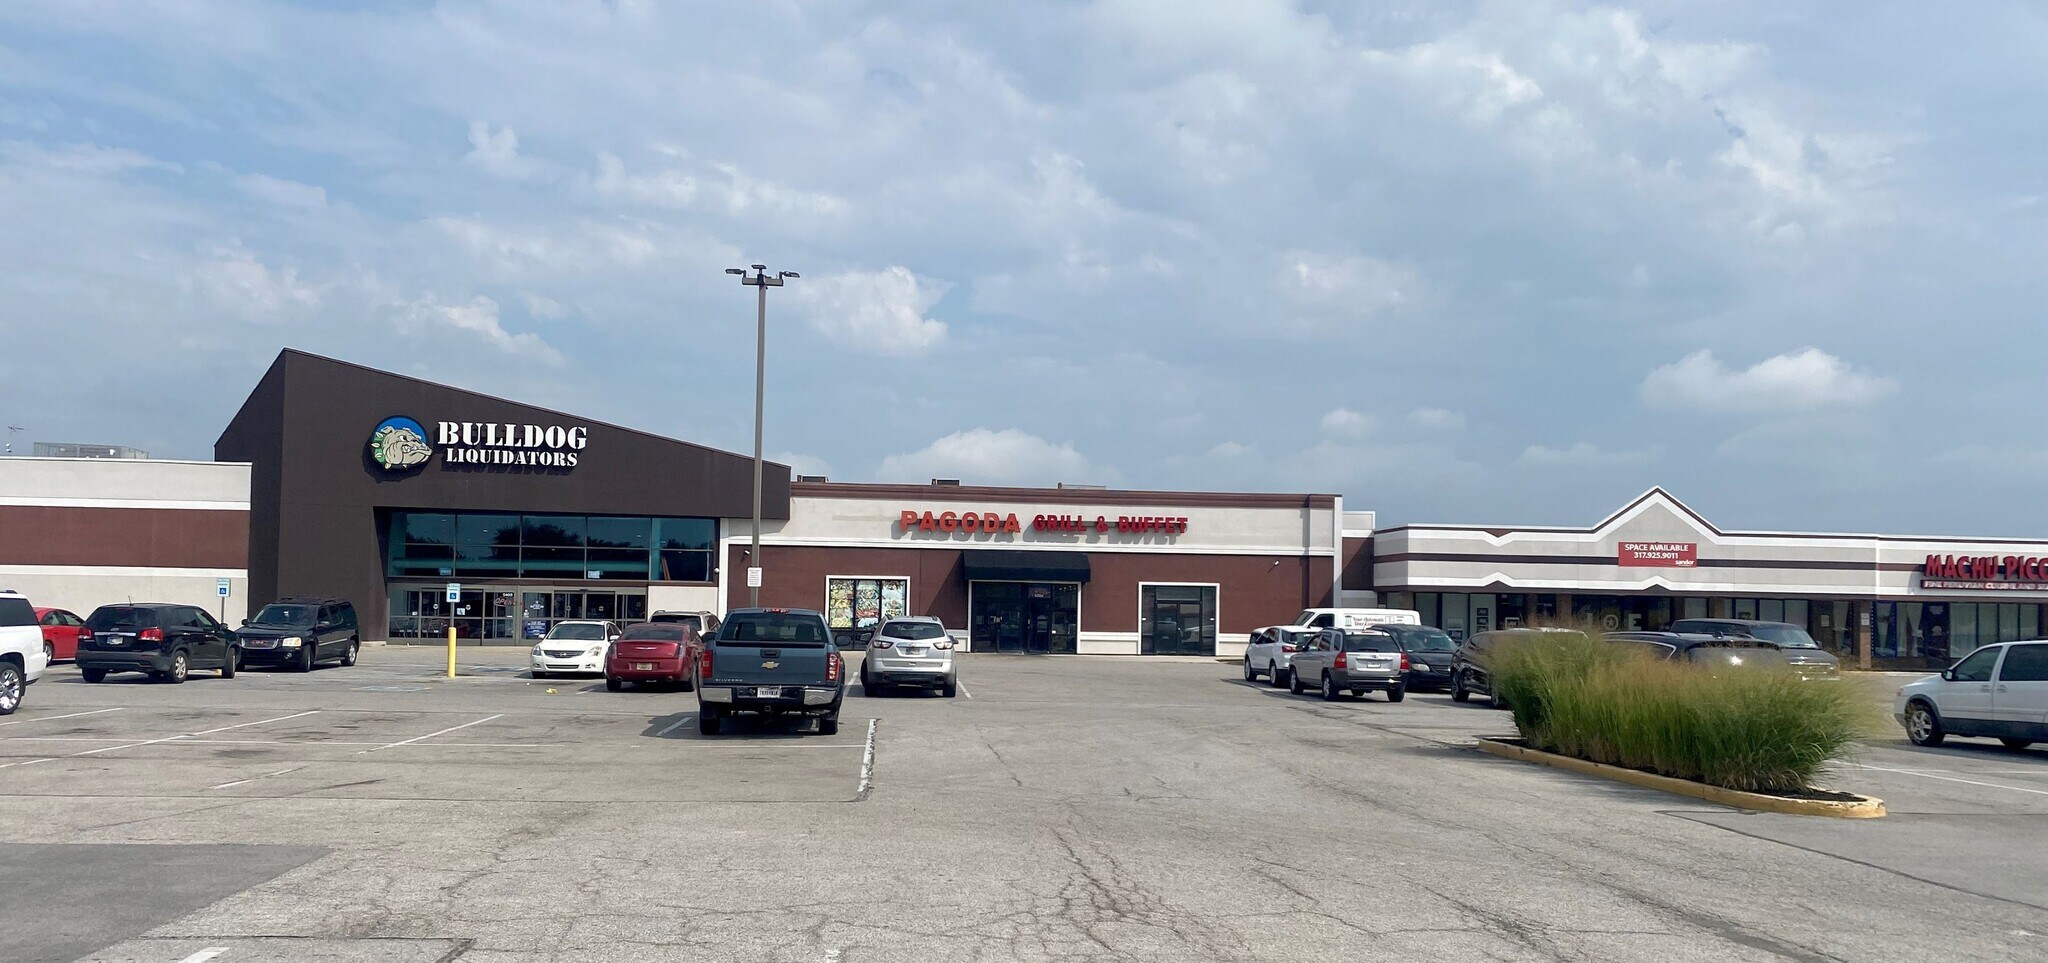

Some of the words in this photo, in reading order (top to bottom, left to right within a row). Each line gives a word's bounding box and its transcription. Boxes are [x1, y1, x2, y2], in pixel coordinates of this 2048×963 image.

[437, 421, 587, 450] BULLDOG
[446, 447, 578, 467] LIQUIDATORS
[900, 510, 1021, 533] PAGODA
[1033, 514, 1087, 532] GRILL
[1095, 515, 1108, 533] &
[1118, 516, 1188, 534] BUFFET
[1649, 544, 1689, 552] AVAILABLE
[1924, 554, 1999, 580] MACHU
